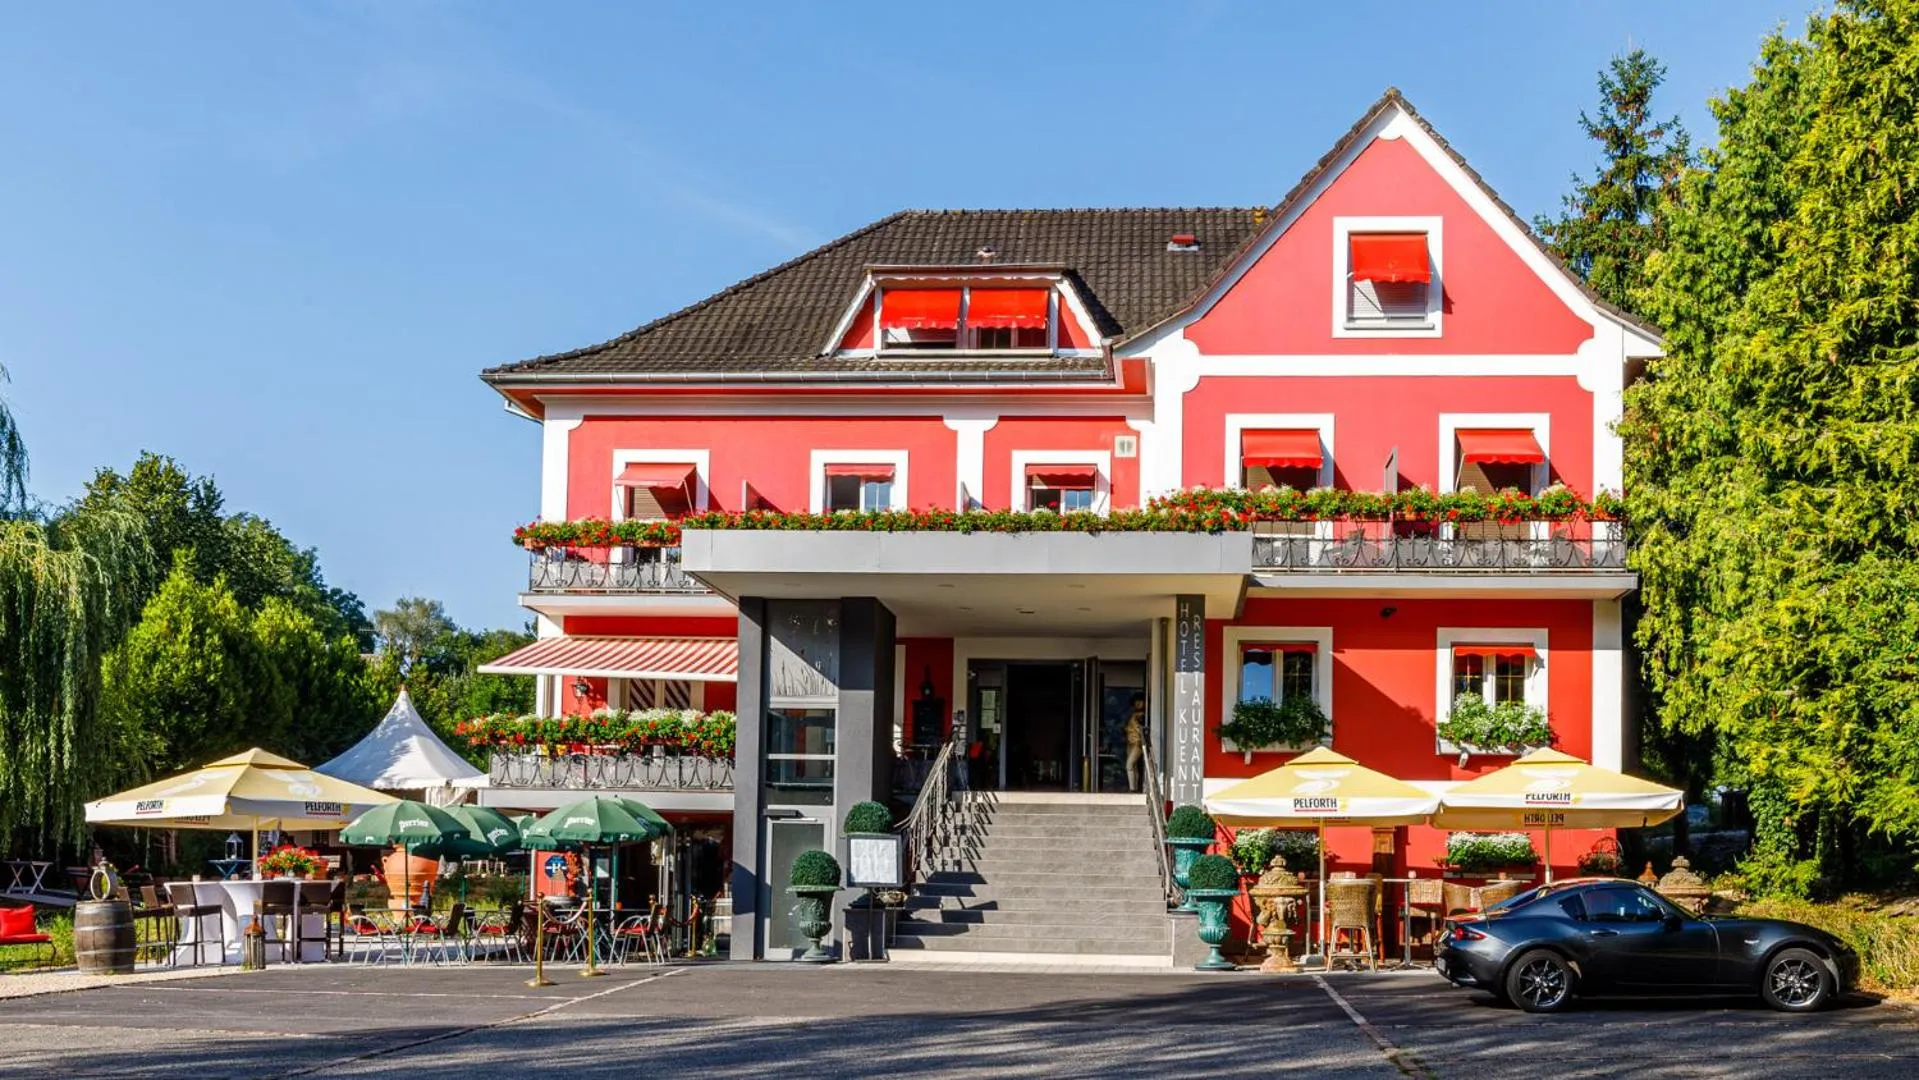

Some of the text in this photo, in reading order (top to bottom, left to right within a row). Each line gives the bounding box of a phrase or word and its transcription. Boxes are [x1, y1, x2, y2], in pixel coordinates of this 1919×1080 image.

[1177, 603, 1189, 805] HOTEL KUENT
[1190, 614, 1201, 800] RESTAURANT
[305, 801, 341, 812] PELFORTH
[1294, 798, 1337, 808] PELFORTH
